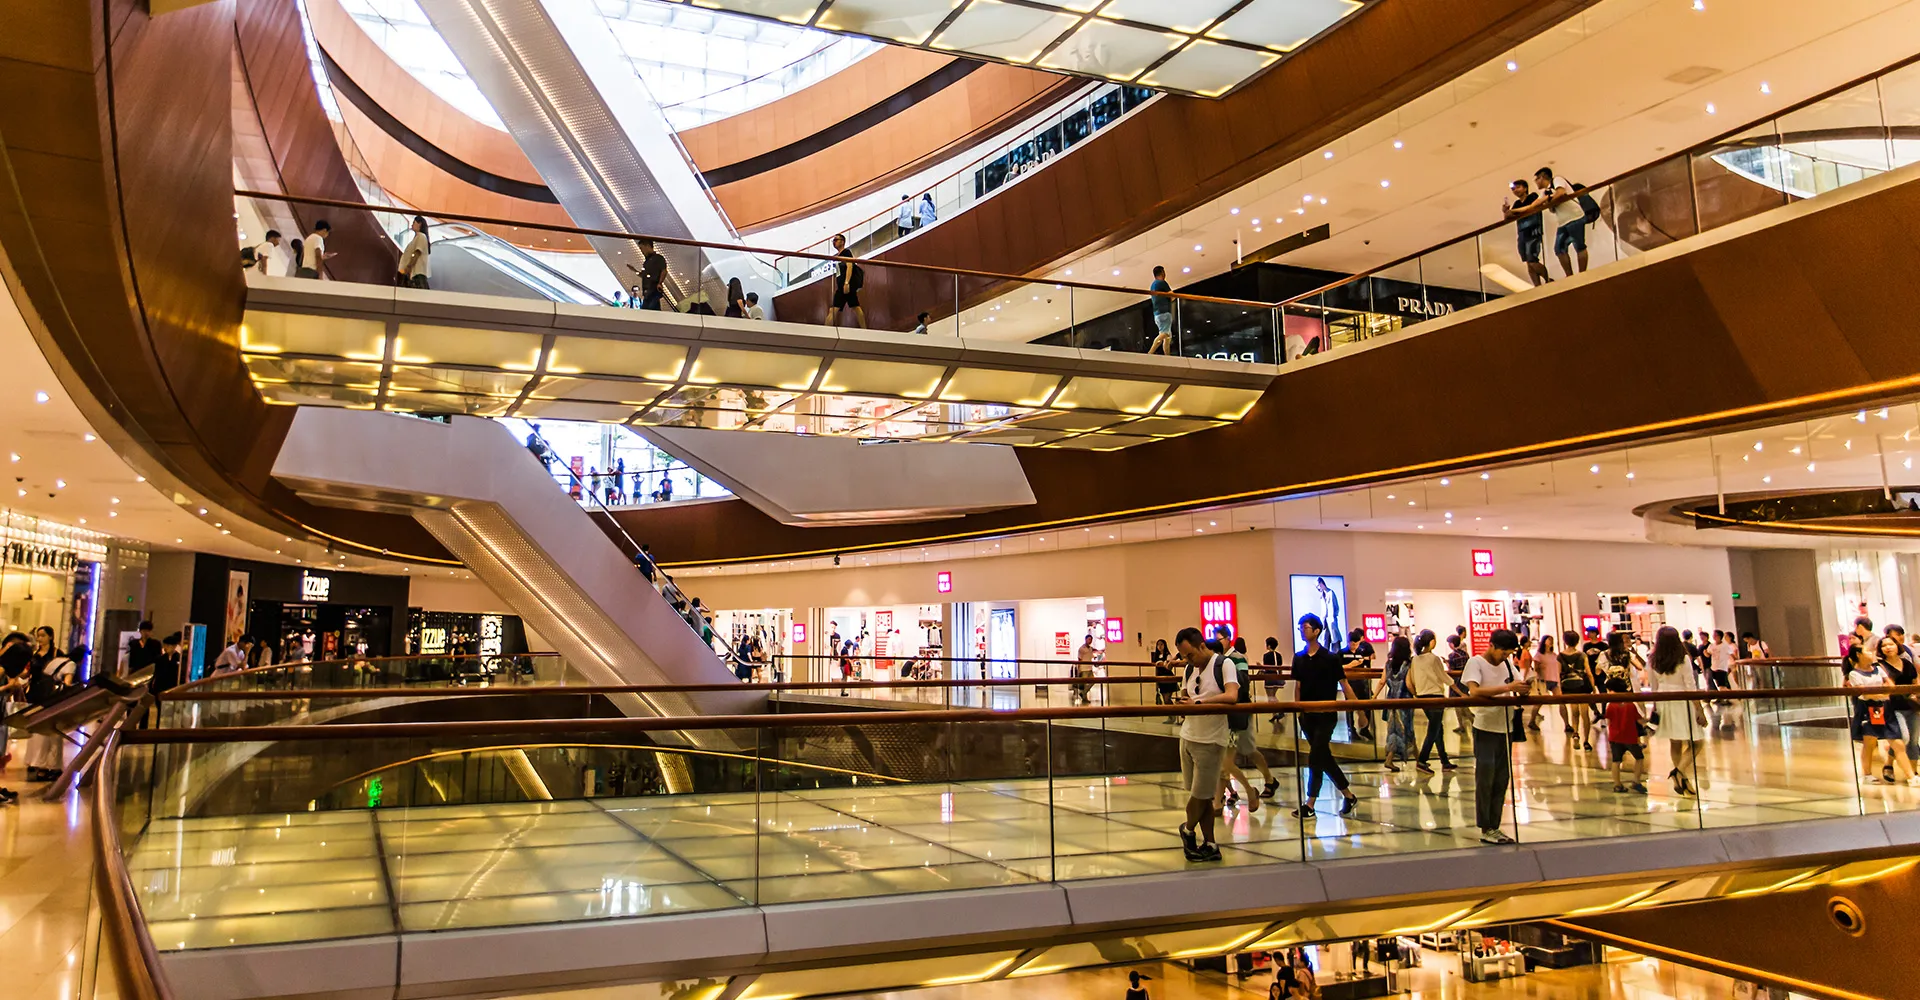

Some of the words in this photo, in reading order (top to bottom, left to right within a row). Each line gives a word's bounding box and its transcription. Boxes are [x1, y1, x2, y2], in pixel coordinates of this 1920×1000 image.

[1398, 297, 1455, 316] PRADA
[304, 570, 329, 595] izzue
[1204, 600, 1231, 621] UNI
[1474, 604, 1501, 616] SALE
[1365, 616, 1383, 628] UNI
[421, 621, 446, 649] izzue
[1366, 628, 1385, 641] QLO
